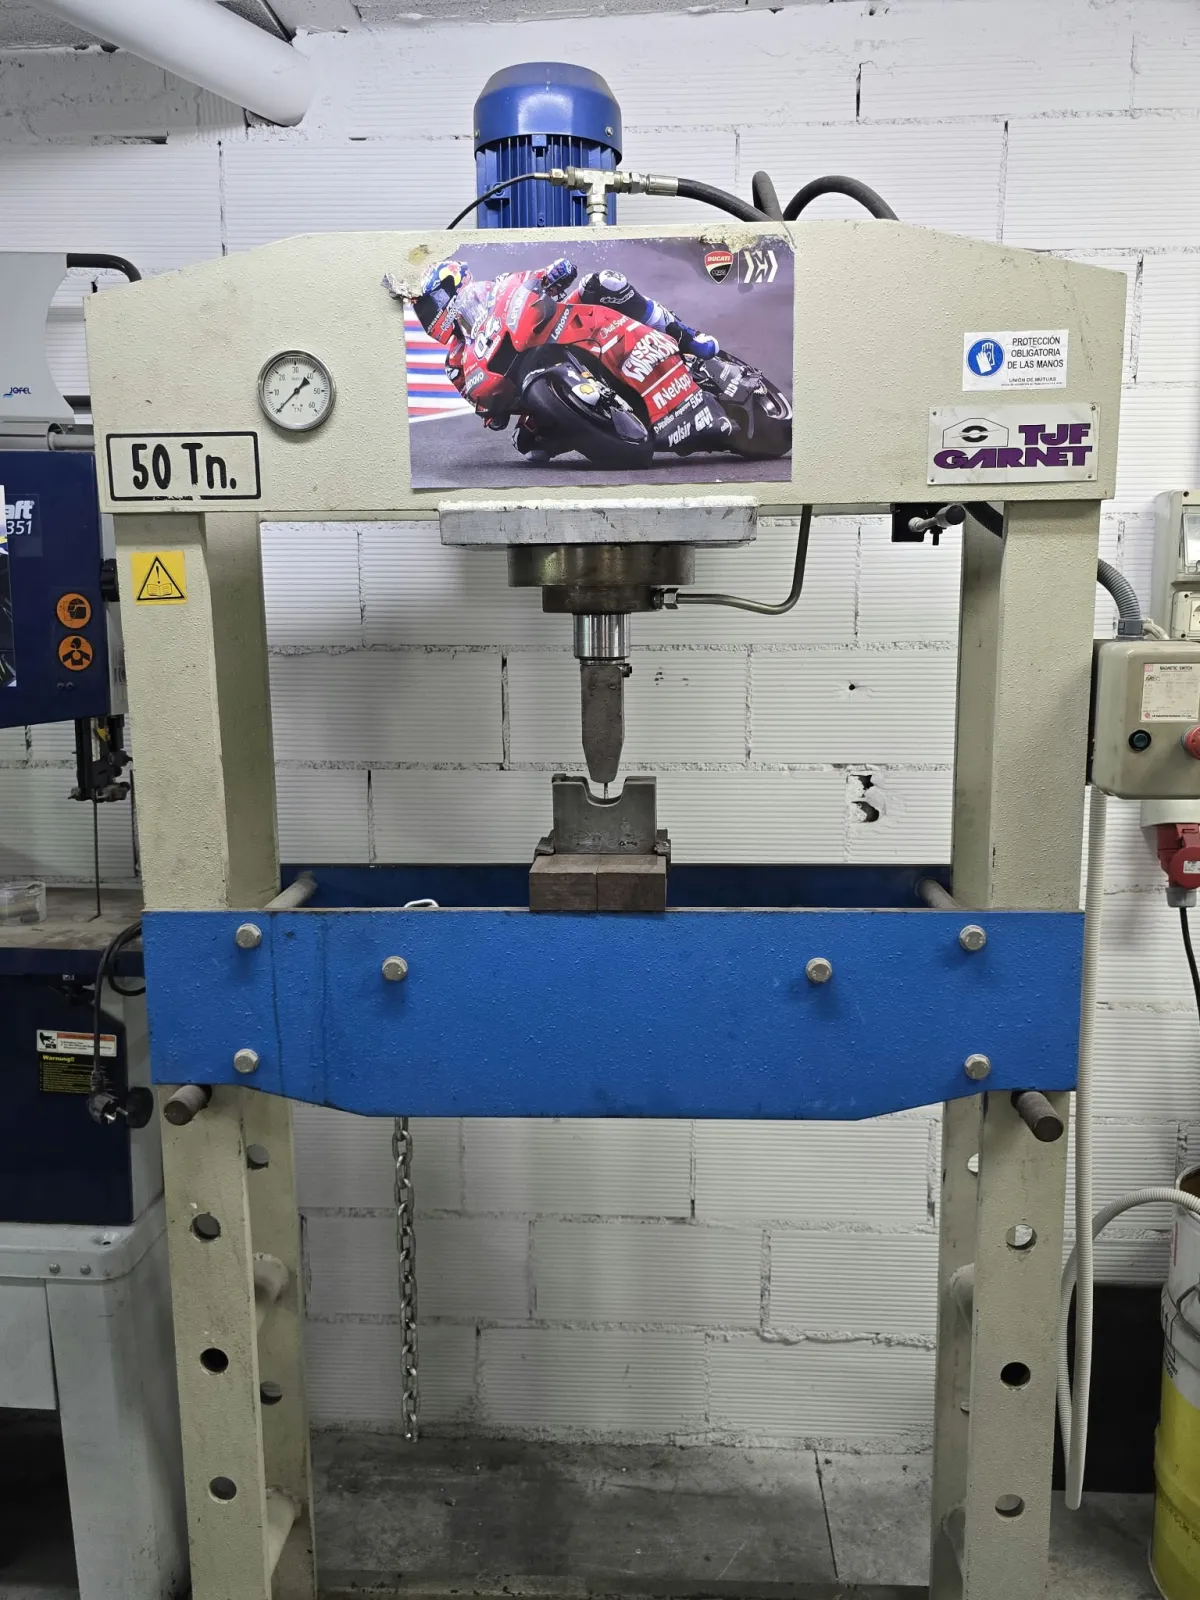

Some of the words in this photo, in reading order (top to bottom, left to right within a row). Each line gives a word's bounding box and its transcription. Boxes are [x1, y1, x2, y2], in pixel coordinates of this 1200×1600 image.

[551, 308, 570, 341] Lenovo
[1012, 335, 1060, 346] PROTECCIÓN
[1007, 361, 1017, 369] DE
[1020, 360, 1034, 369] LAS
[1037, 359, 1064, 369] MANOS
[1011, 348, 1061, 358] OBLIGATORIA
[1018, 423, 1091, 446] TJF
[132, 443, 171, 490] 50
[181, 443, 237, 490] Tn.
[933, 446, 1093, 469] GARNET
